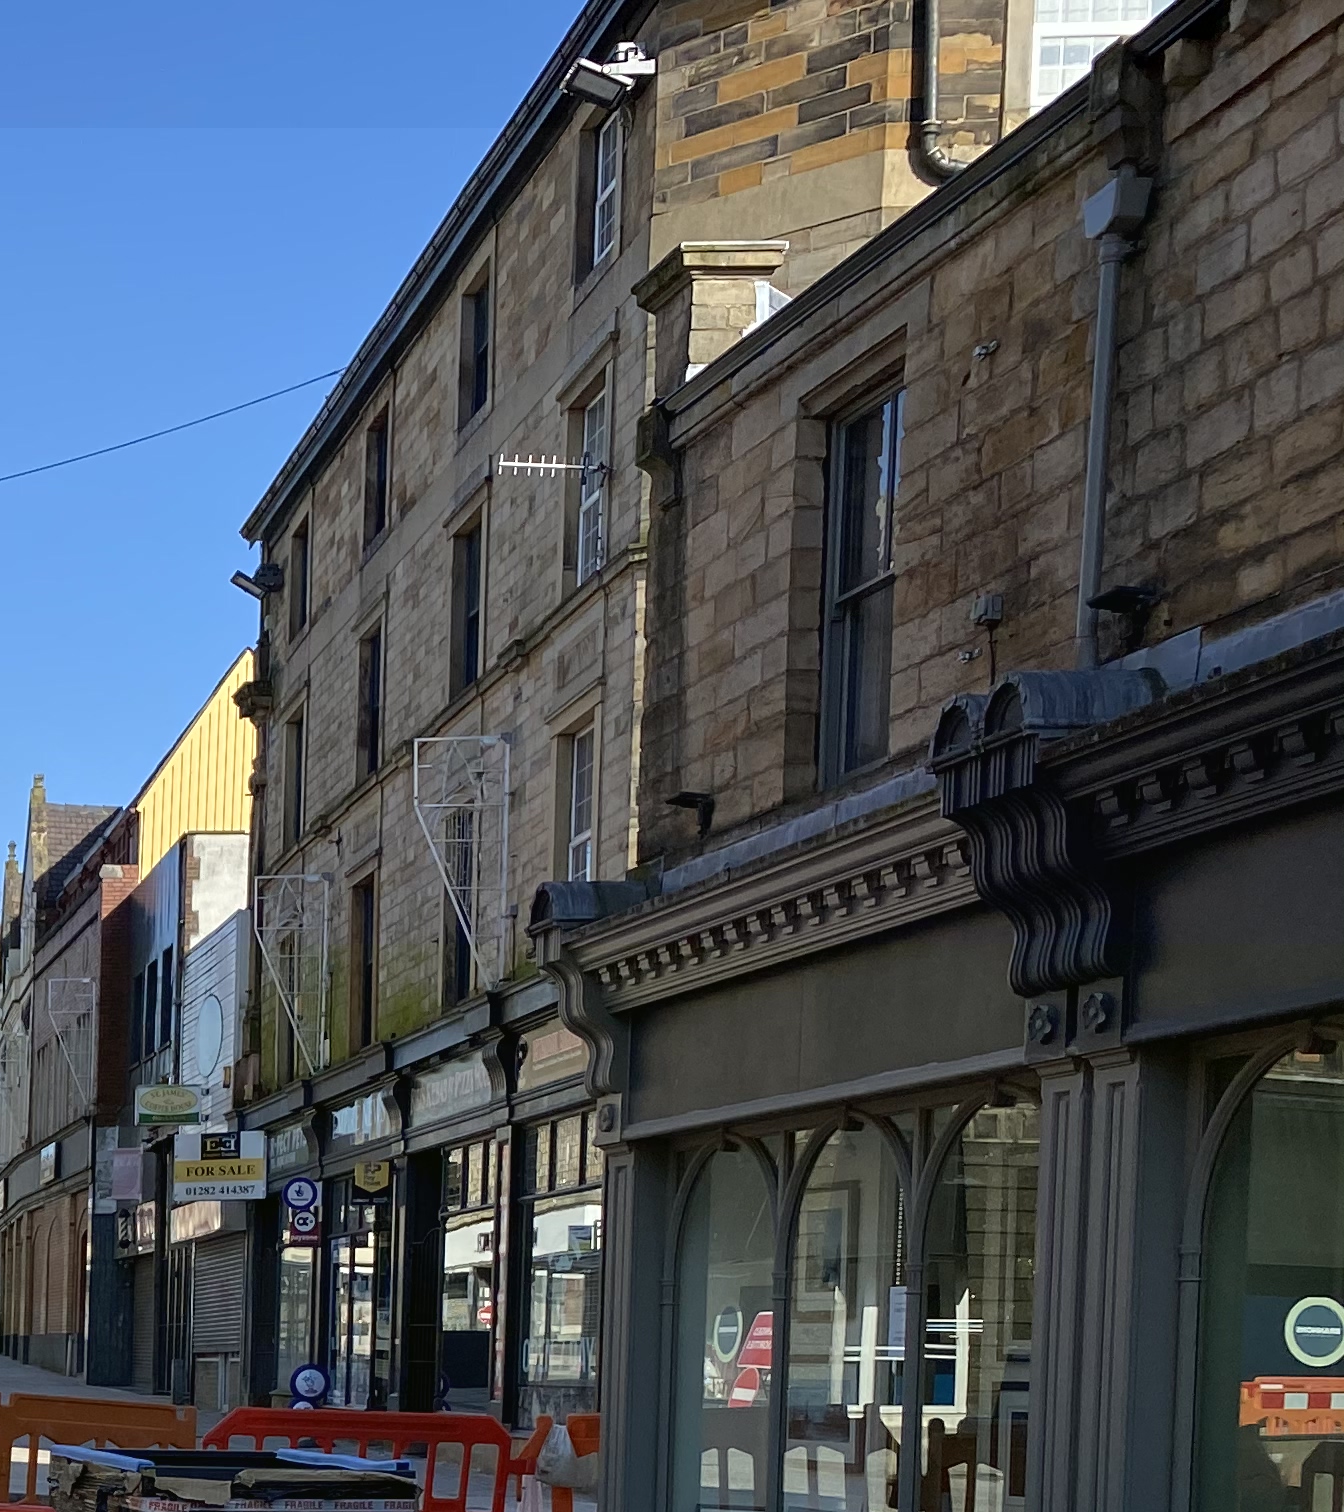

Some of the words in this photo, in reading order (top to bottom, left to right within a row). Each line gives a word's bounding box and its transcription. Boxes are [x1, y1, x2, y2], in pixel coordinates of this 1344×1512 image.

[185, 1166, 215, 1177] FOR
[218, 1164, 256, 1176] SALE
[185, 1186, 216, 1196] 01282
[218, 1184, 256, 1195] 414387
[148, 1500, 189, 1512] FRAGILE
[284, 1500, 324, 1510] FRAGILE
[334, 1500, 374, 1510] FRAGILE
[384, 1500, 413, 1510] FRAGI
